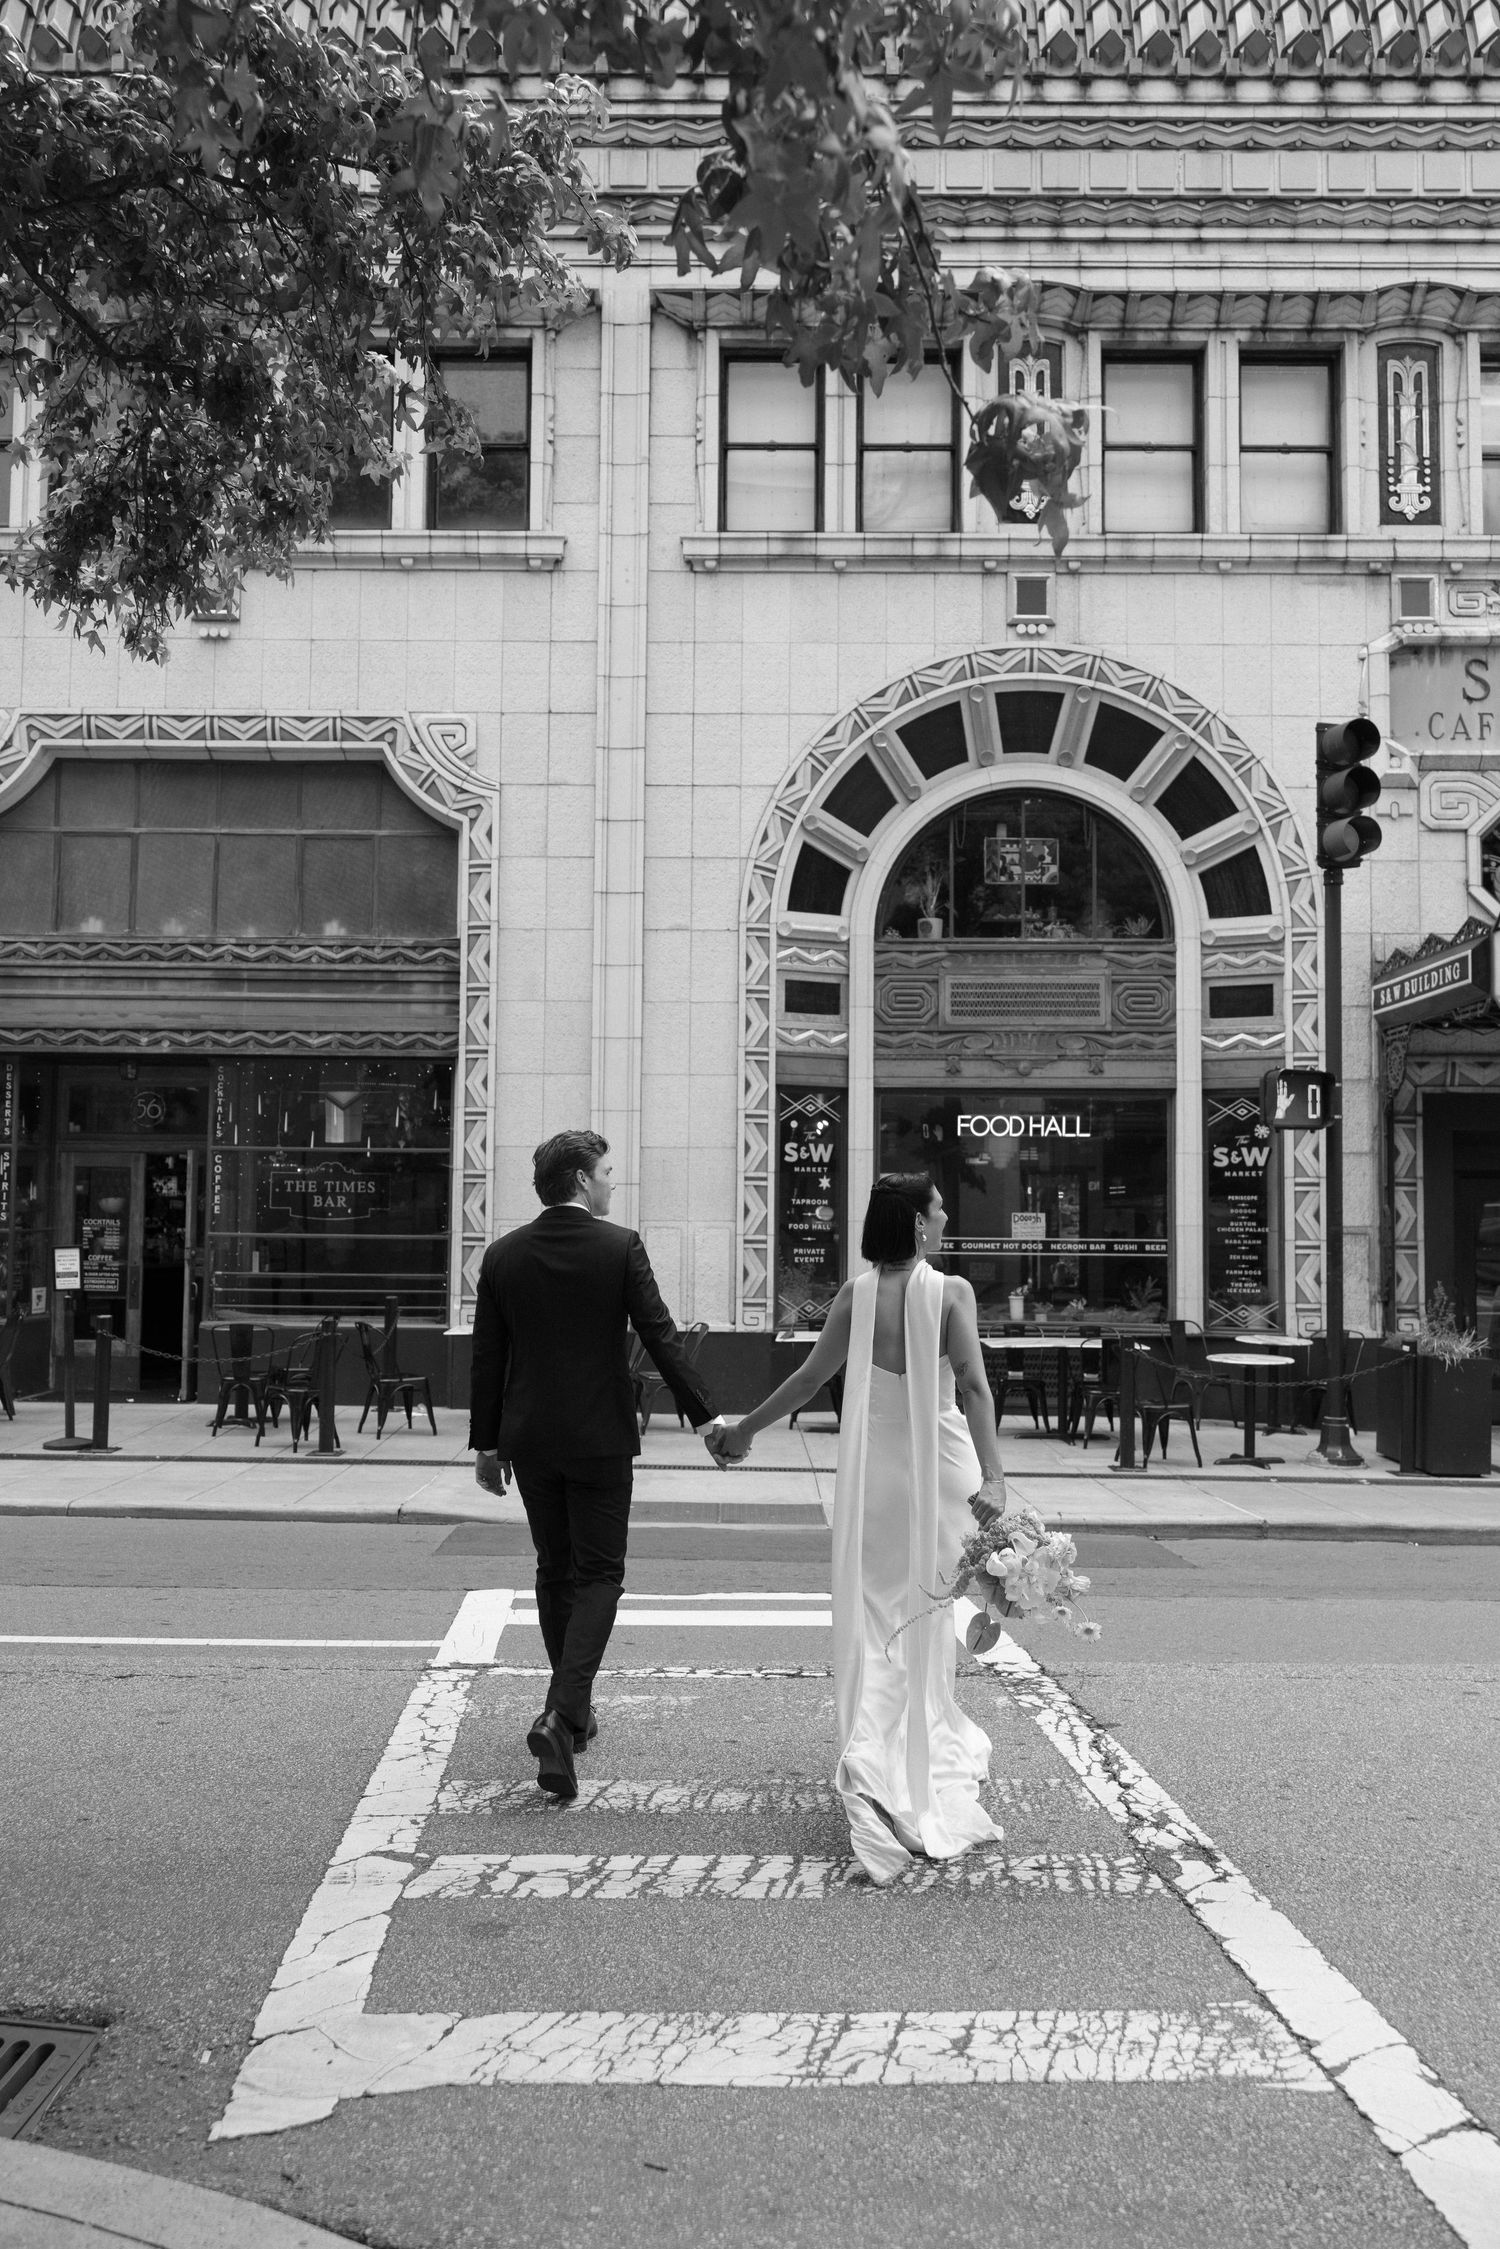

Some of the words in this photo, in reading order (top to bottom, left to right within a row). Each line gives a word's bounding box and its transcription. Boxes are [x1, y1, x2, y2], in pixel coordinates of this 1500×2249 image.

[1380, 984, 1404, 1006] S&W
[1404, 962, 1461, 997] BUILDING
[4, 1064, 13, 1136] DESSERTS
[137, 1099, 161, 1119] 56
[216, 1065, 225, 1138] COCKTAILS
[957, 1115, 1025, 1137] FOOD
[1029, 1115, 1091, 1137] HALL
[784, 1142, 834, 1163] S&W
[1213, 1146, 1270, 1168] S&W
[0, 1152, 10, 1221] SPIRITS
[214, 1154, 222, 1214] COFFEE
[284, 1180, 317, 1192] THE
[324, 1181, 376, 1193] TIMES
[313, 1195, 347, 1207] BAR
